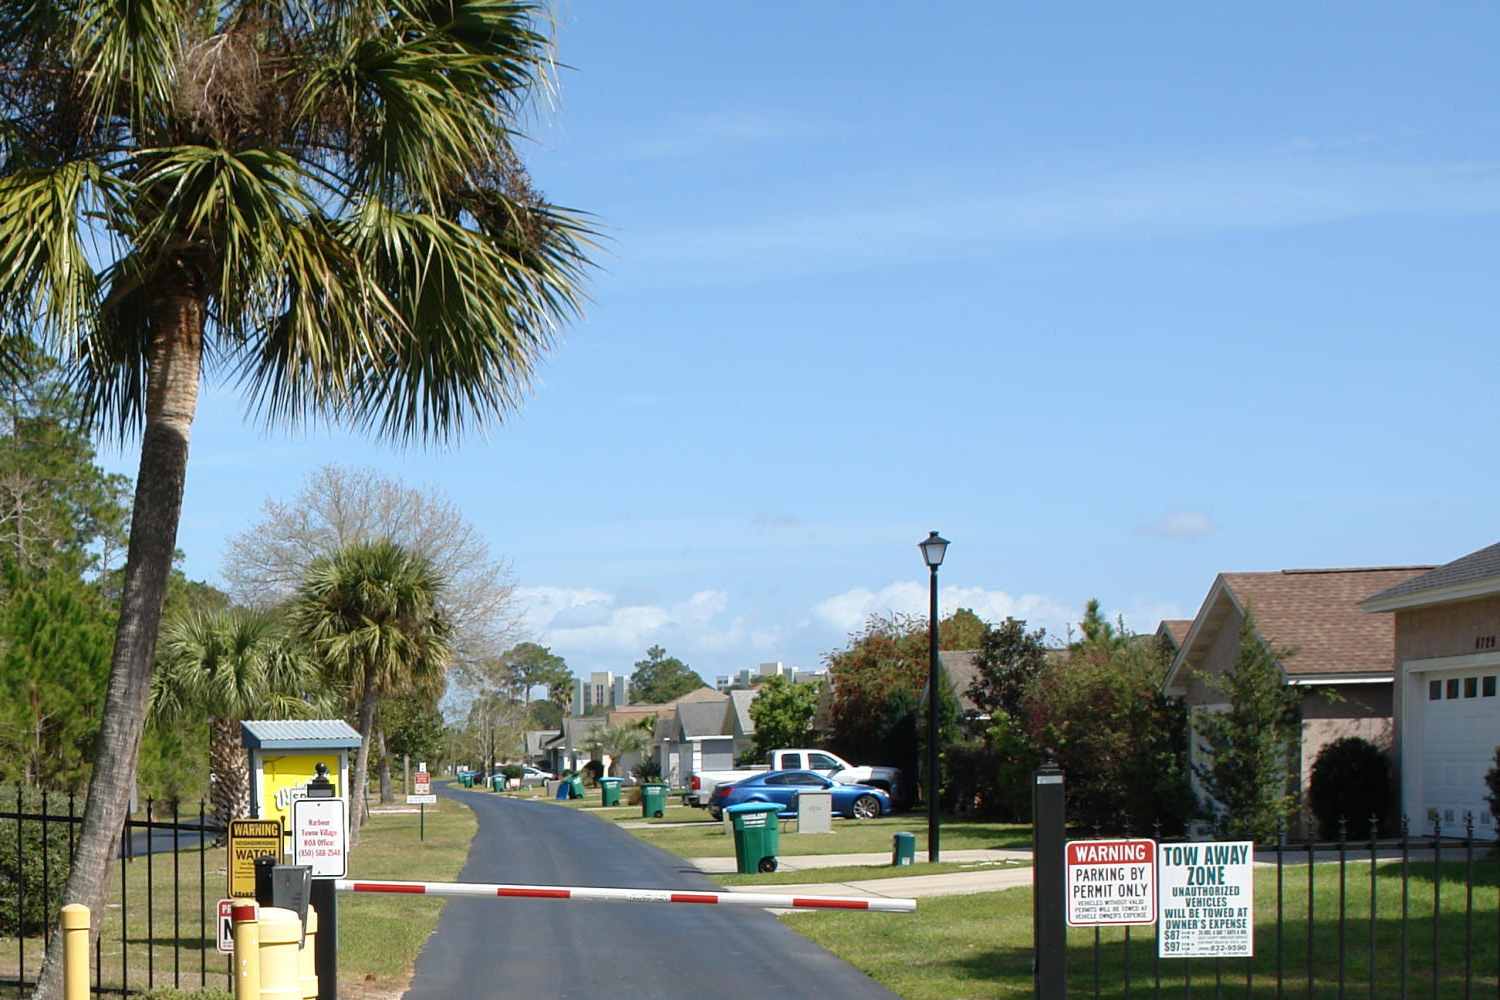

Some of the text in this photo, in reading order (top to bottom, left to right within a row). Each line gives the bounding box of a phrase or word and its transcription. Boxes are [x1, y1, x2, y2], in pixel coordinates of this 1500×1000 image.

[234, 824, 278, 836] WARNING
[236, 849, 276, 860] WATCH
[1076, 845, 1146, 862] WARNING
[1164, 845, 1248, 866] TOW AWAY
[1076, 867, 1145, 882] PARKING BY
[1187, 866, 1225, 886] ZONE
[1073, 883, 1148, 898] PERMIT ONLY
[1172, 886, 1240, 896] UNAUTHORIZED
[1186, 897, 1227, 907] VEHICLES
[1165, 907, 1248, 918] WILL BE TOWED AT
[1166, 919, 1247, 929] OWNER'S EXPENSE
[1164, 930, 1180, 940] $87
[1164, 942, 1180, 952] $97
